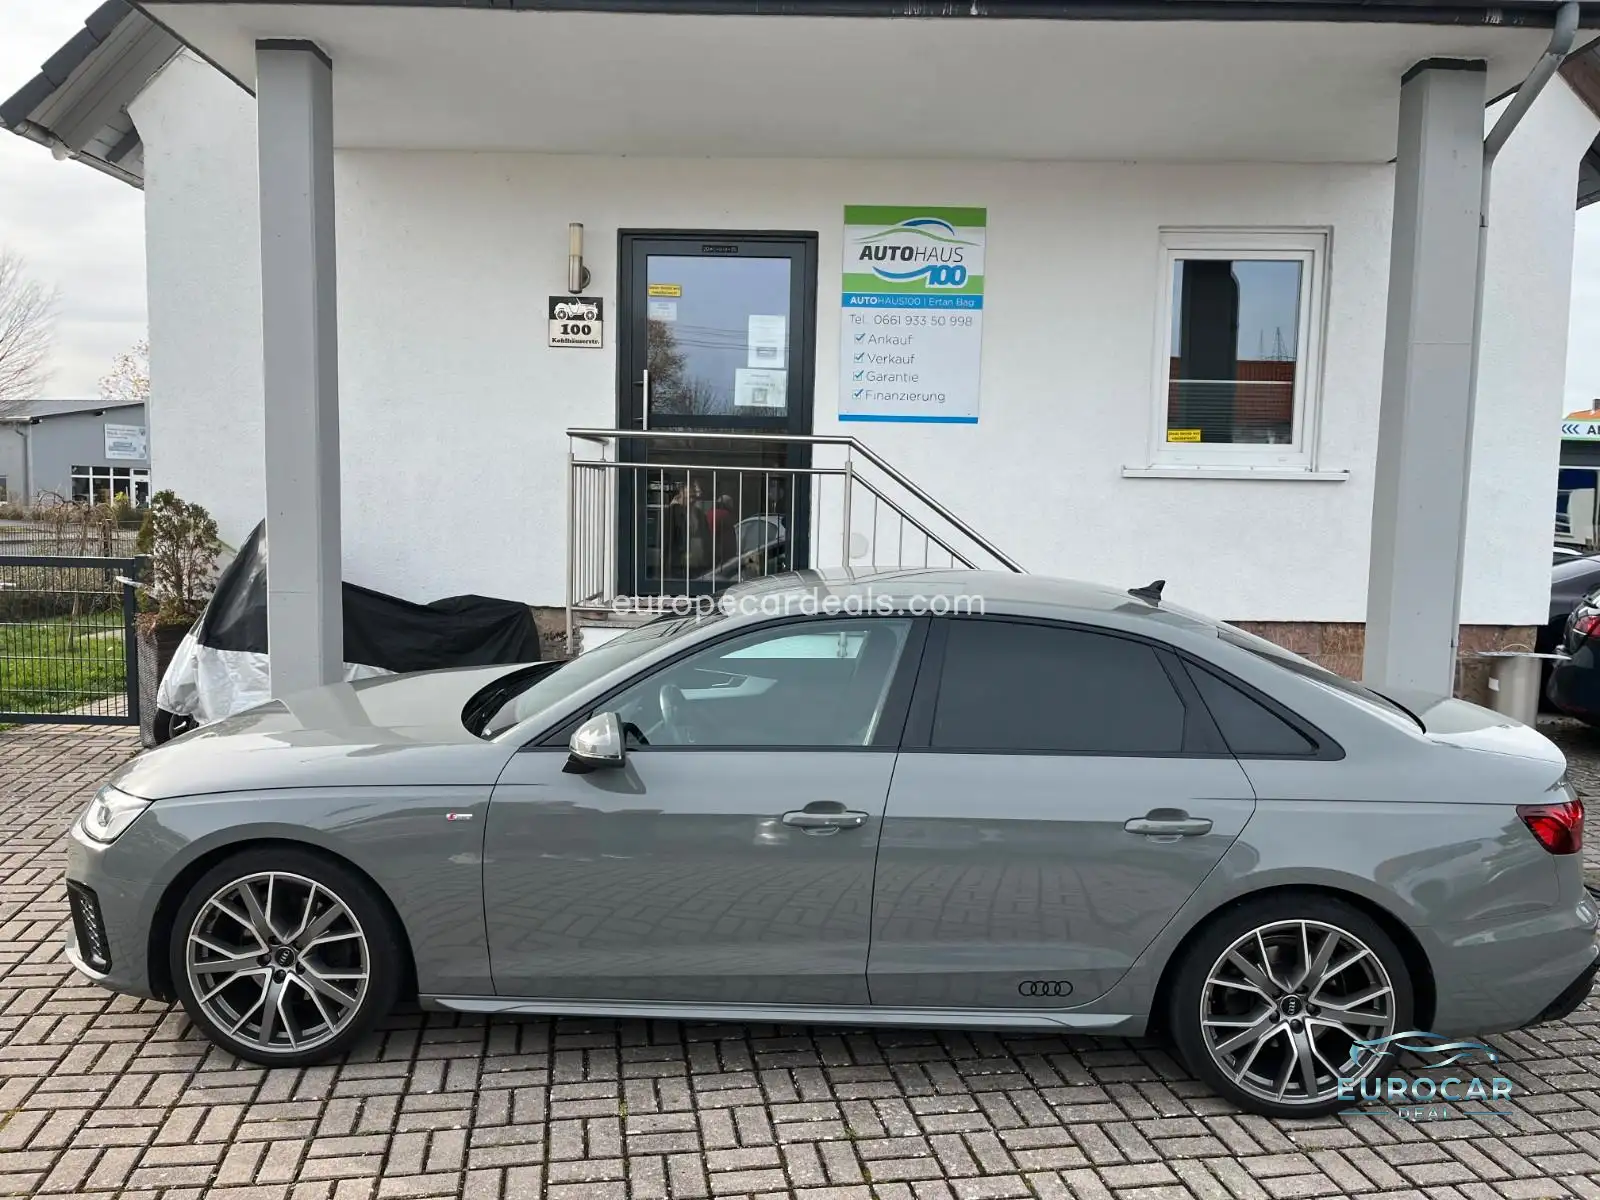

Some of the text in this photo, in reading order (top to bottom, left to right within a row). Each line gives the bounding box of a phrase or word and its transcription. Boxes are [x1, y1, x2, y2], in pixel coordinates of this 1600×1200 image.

[859, 245, 964, 263] AUTOHAUS
[927, 264, 967, 286] 100
[850, 296, 921, 305] AUTOHAUS100
[928, 298, 953, 306] Ertan
[873, 314, 901, 325] 0661
[905, 315, 927, 326] 933
[930, 316, 946, 326] 50
[949, 316, 973, 327] 998
[560, 324, 592, 335] 100
[867, 334, 913, 346] Ankauf
[867, 353, 915, 365] Verkauf
[866, 371, 919, 383] Garantie
[865, 390, 946, 404] Finanzierung
